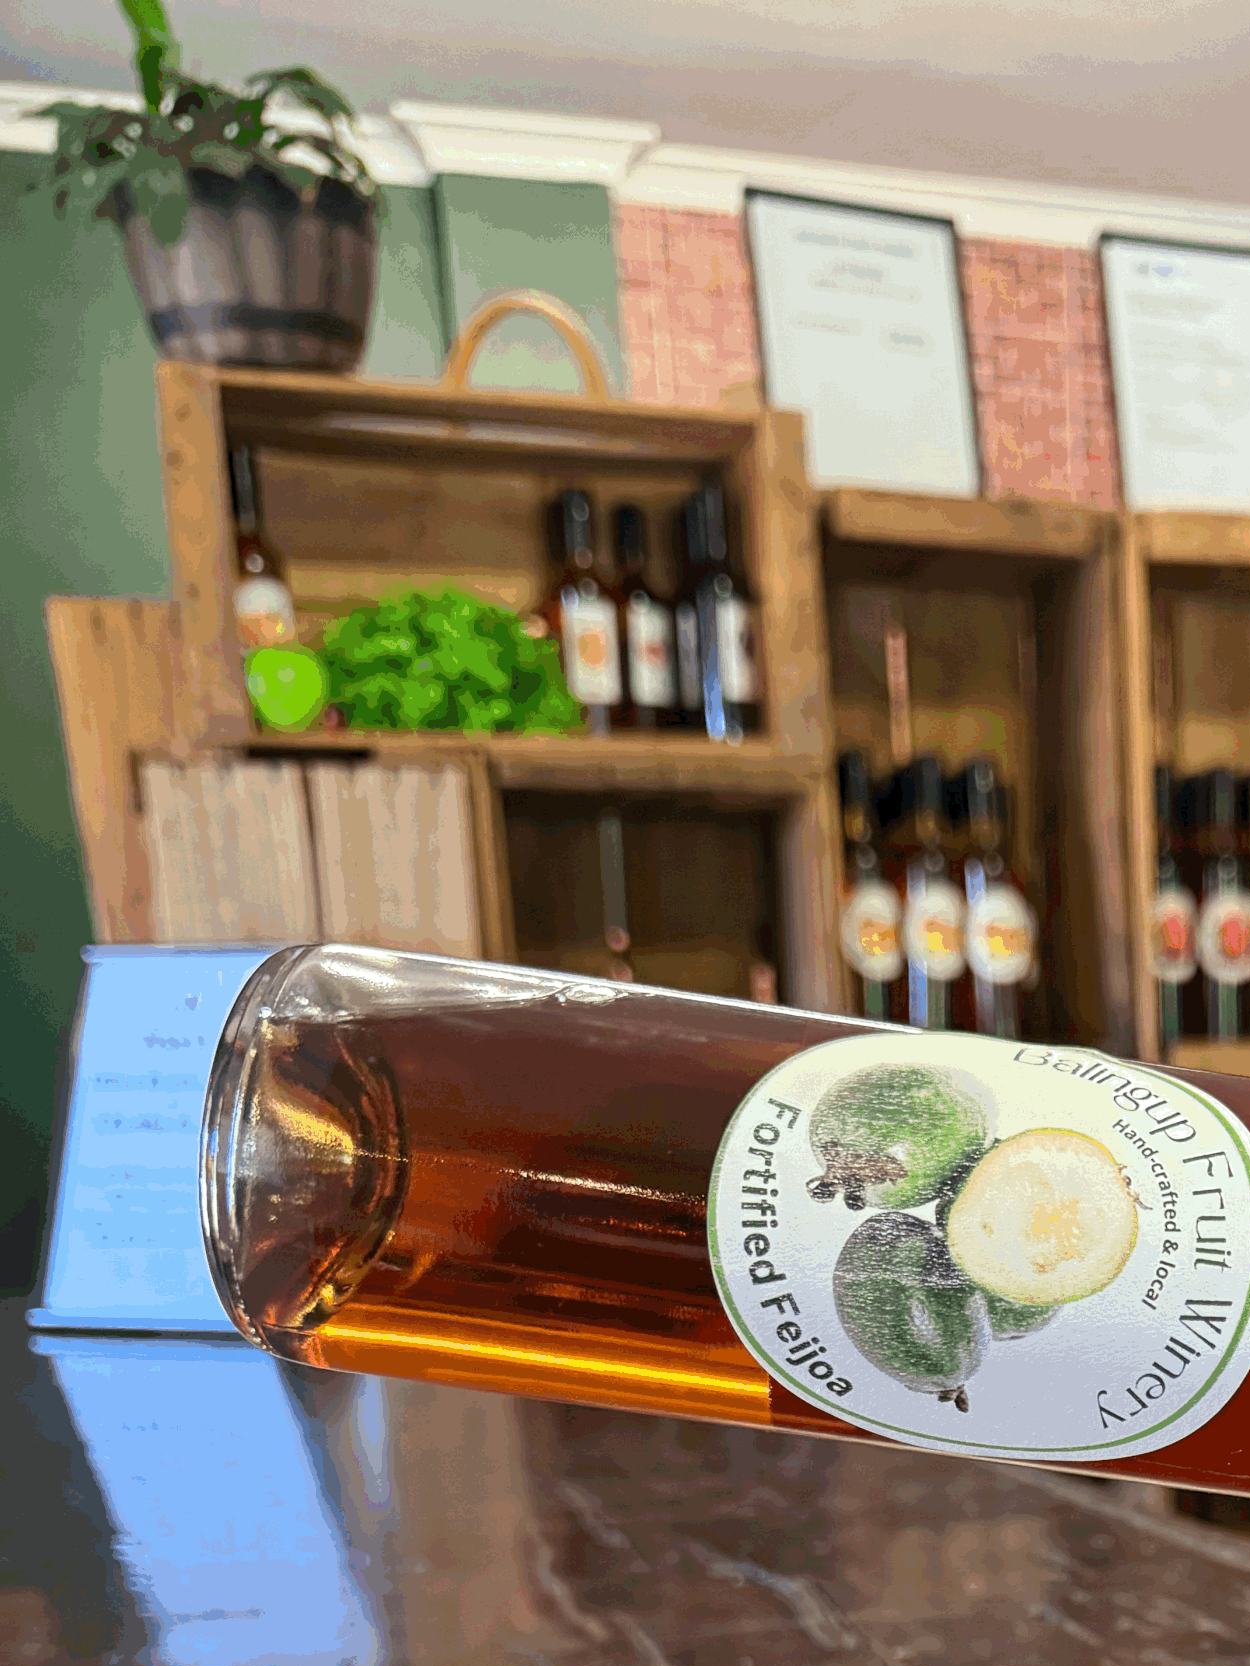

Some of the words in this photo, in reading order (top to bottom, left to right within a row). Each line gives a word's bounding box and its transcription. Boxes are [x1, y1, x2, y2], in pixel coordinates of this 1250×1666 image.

[1013, 1047, 1197, 1143] Balingup
[740, 1098, 802, 1286] Fortified
[1112, 1118, 1182, 1233] Hand-crafted
[1182, 1151, 1234, 1273] Fruit
[1141, 1260, 1177, 1311] local
[1162, 1239, 1179, 1256] &
[760, 1292, 854, 1398] Feijoa
[1097, 1299, 1233, 1429] Winery
